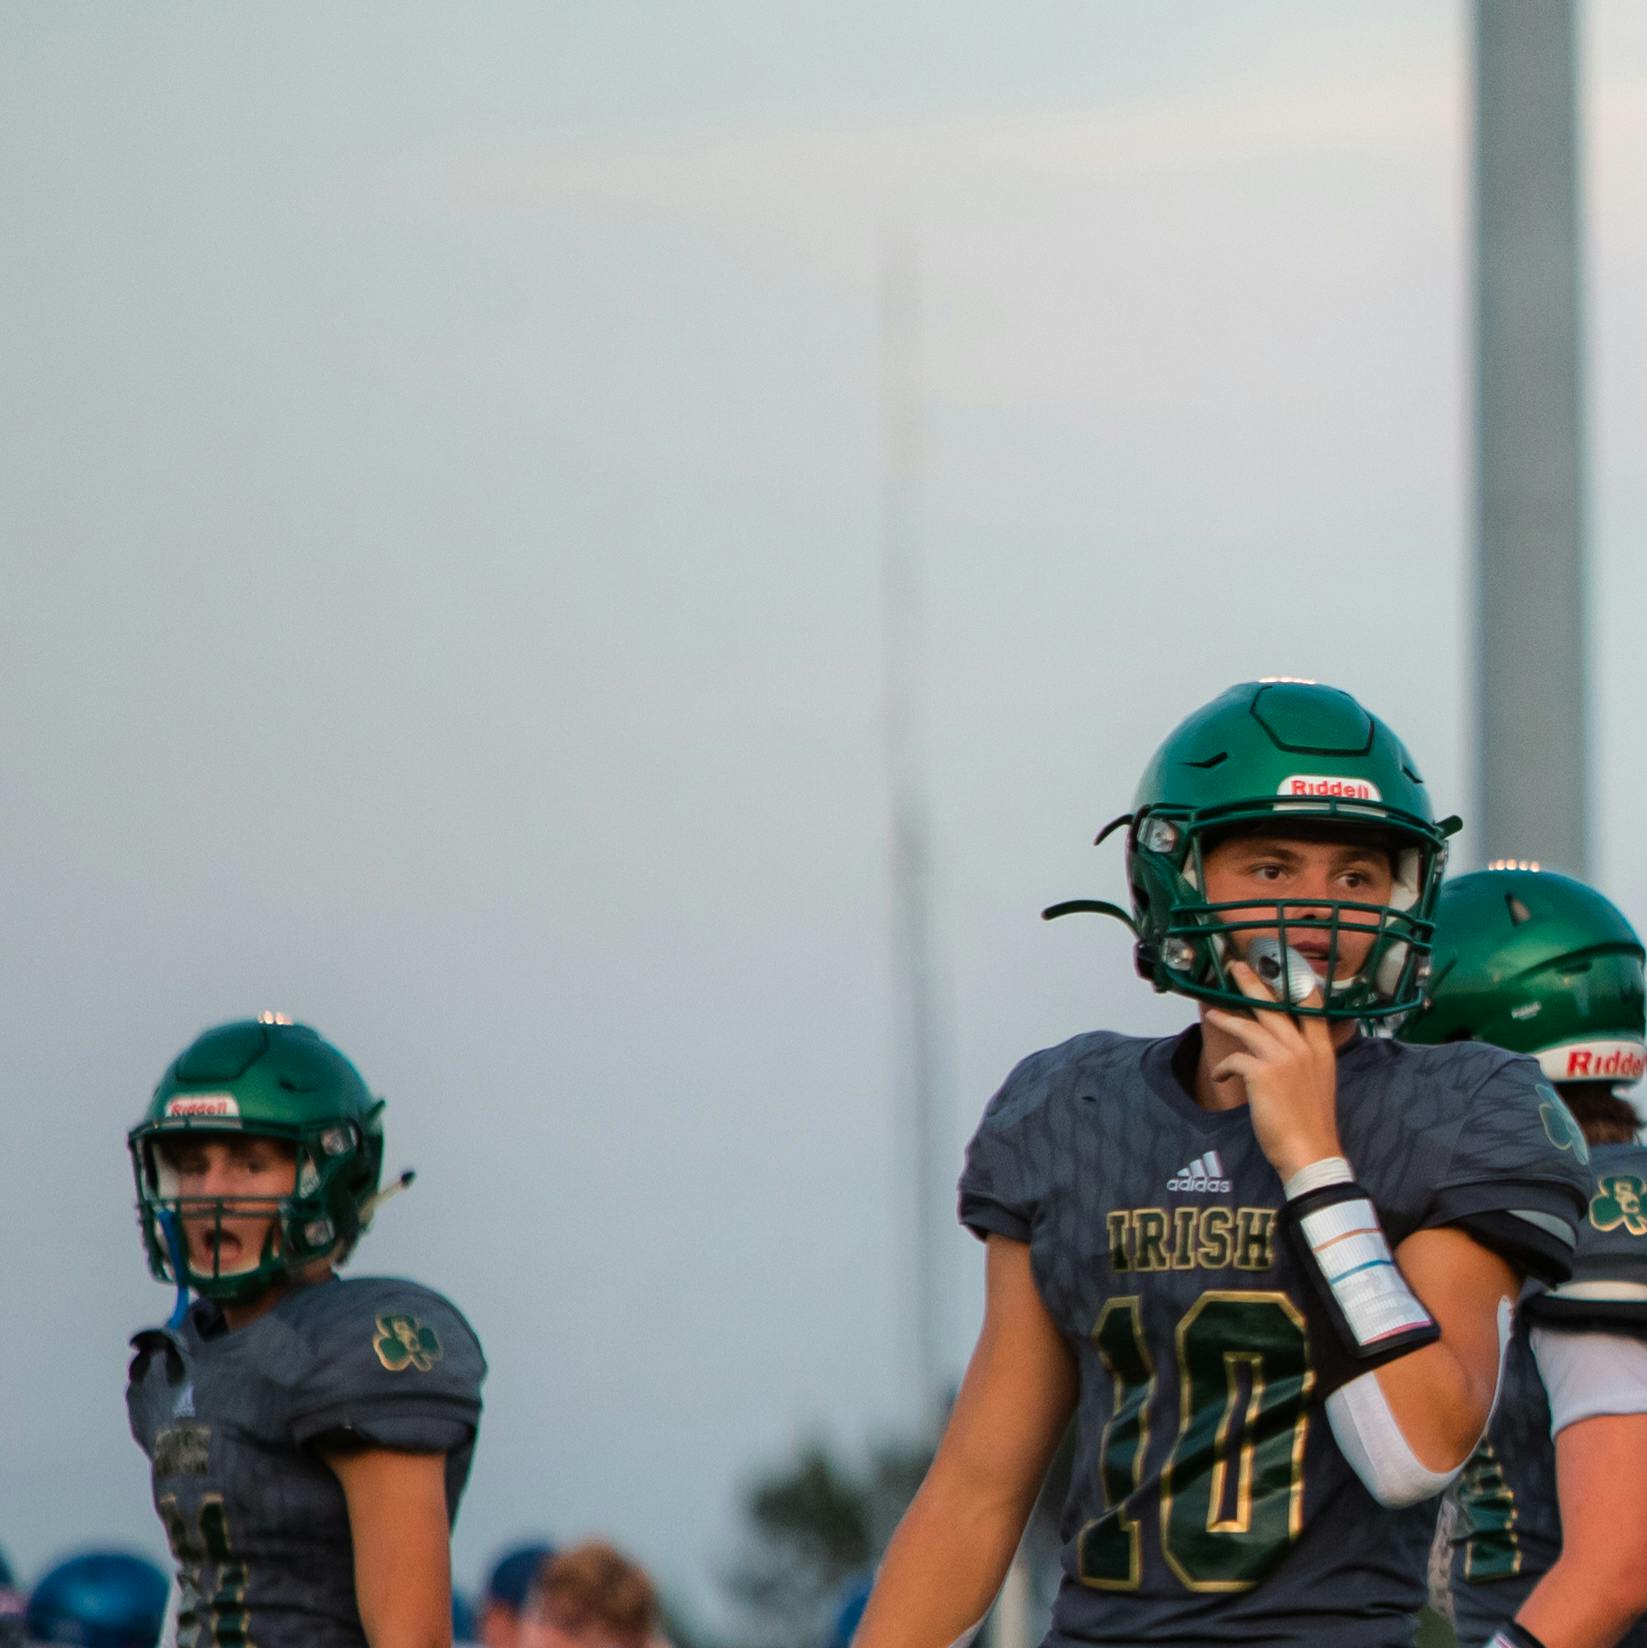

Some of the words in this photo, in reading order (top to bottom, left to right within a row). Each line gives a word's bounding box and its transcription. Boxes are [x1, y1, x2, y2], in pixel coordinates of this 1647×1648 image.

[1291, 780, 1370, 799] Riddell
[1166, 1176, 1231, 1193] adidas
[1106, 1206, 1278, 1273] IRISH
[1078, 1290, 1317, 1594] 10
